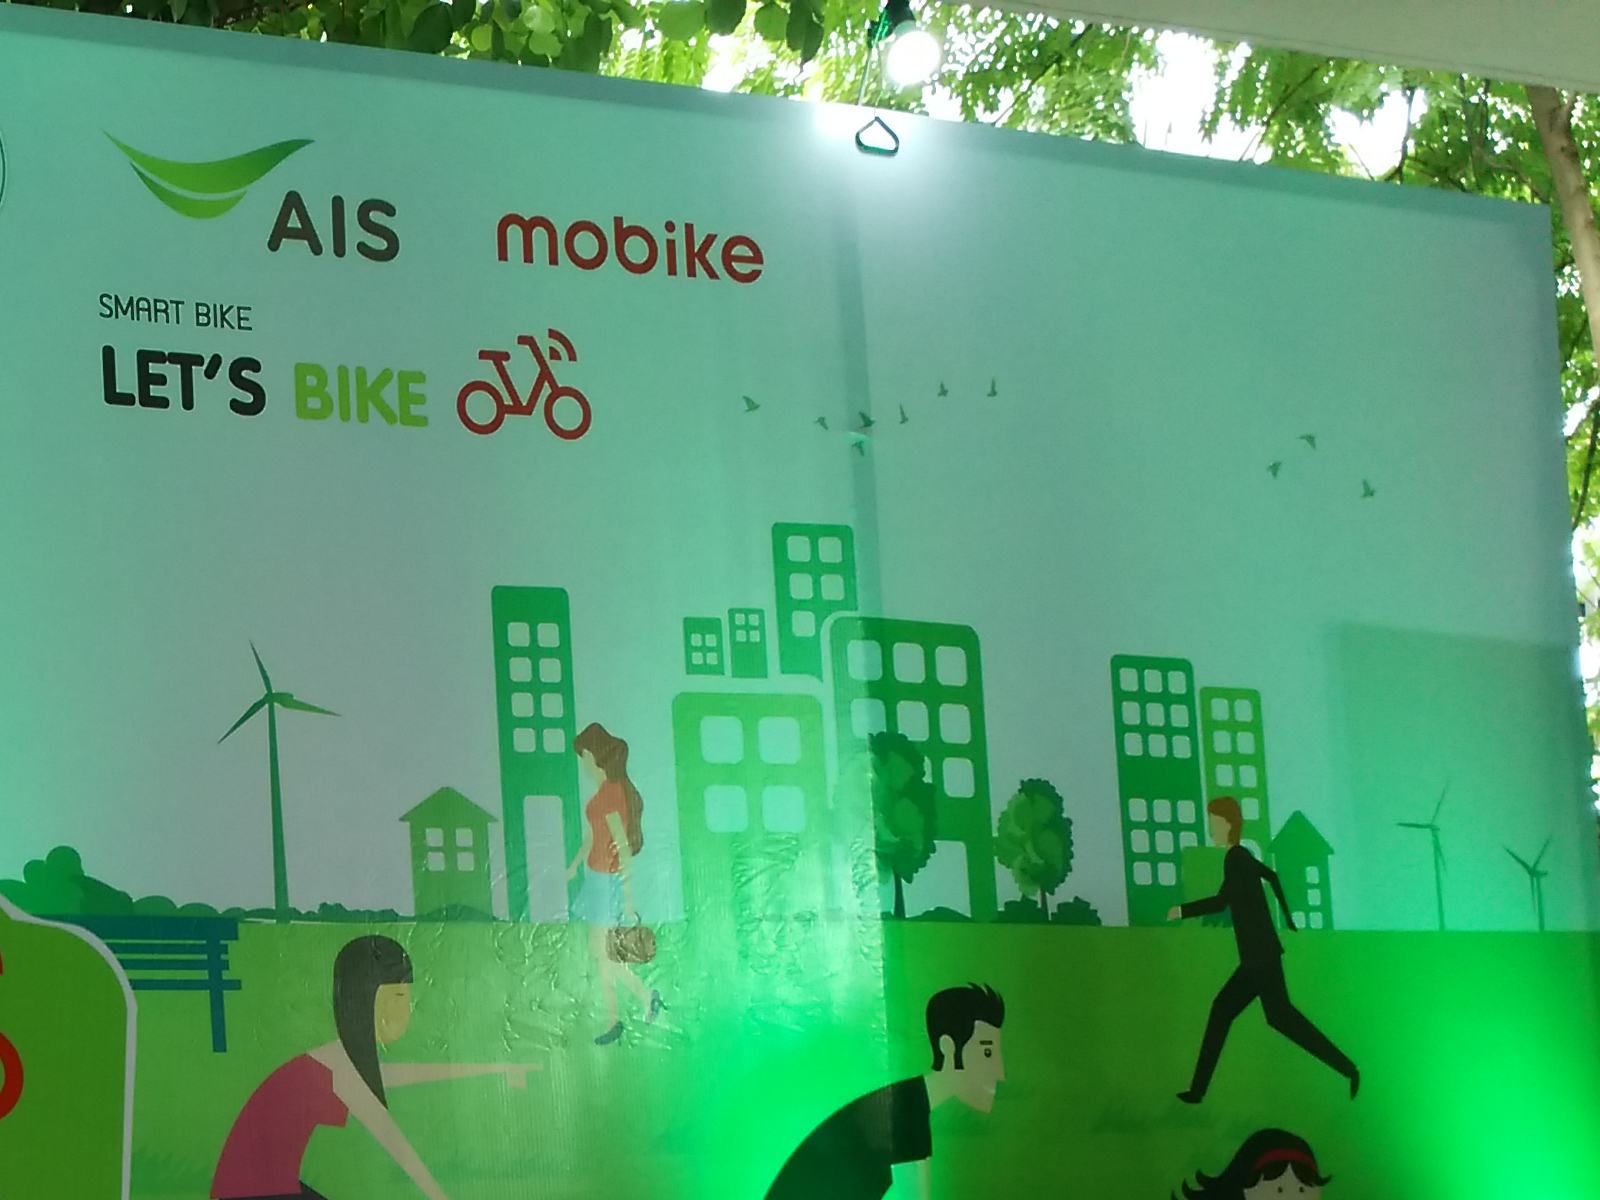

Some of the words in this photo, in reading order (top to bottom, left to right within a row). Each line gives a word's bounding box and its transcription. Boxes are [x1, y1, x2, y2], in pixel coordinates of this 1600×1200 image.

[267, 190, 401, 262] AIS
[497, 212, 765, 284] mobike
[99, 293, 185, 325] SMART
[195, 302, 254, 331] BIKE
[101, 345, 267, 417] LET'S
[293, 362, 430, 427] BIKE
